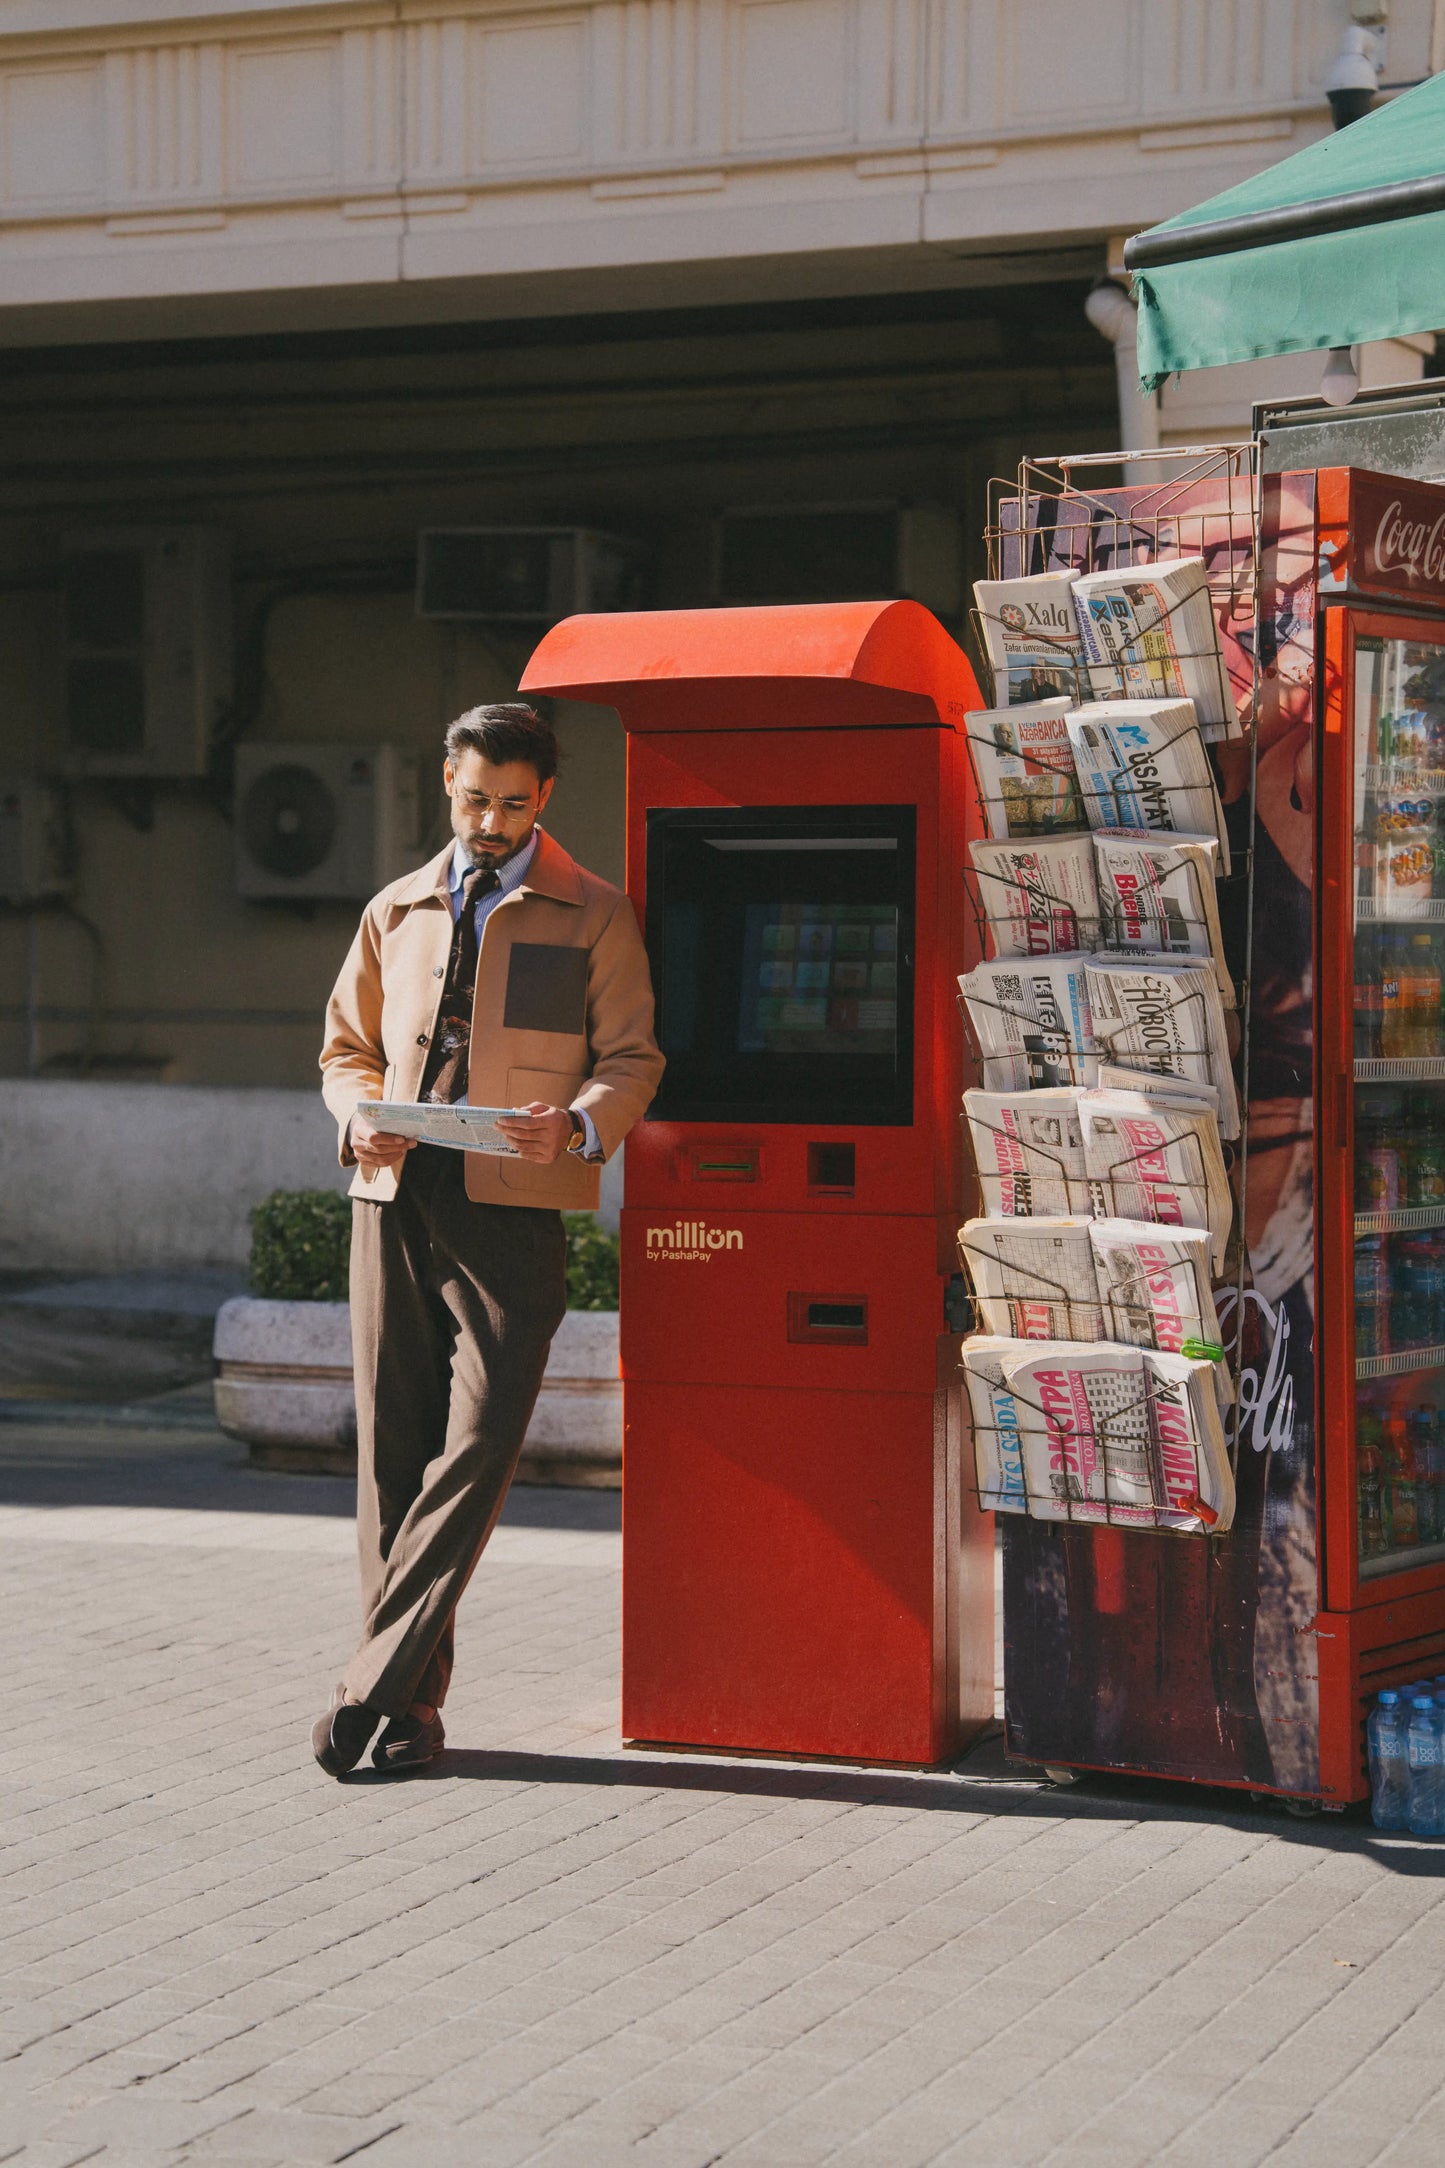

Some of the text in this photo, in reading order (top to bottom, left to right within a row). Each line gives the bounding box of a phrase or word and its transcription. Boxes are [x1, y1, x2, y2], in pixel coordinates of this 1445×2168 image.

[1025, 602, 1071, 633] Xalq
[1111, 600, 1135, 650] BAKI
[1114, 874, 1142, 939] Время
[1135, 894, 1148, 926] НОВОЕ
[646, 1220, 744, 1250] million
[646, 1250, 712, 1263] by PashaPay
[1135, 1244, 1184, 1353] EKSTRA
[1151, 1372, 1182, 1406] 24
[1032, 1371, 1079, 1472] ЭКСТРА
[1072, 1372, 1094, 1465] ГОЛОВОЛОМКА
